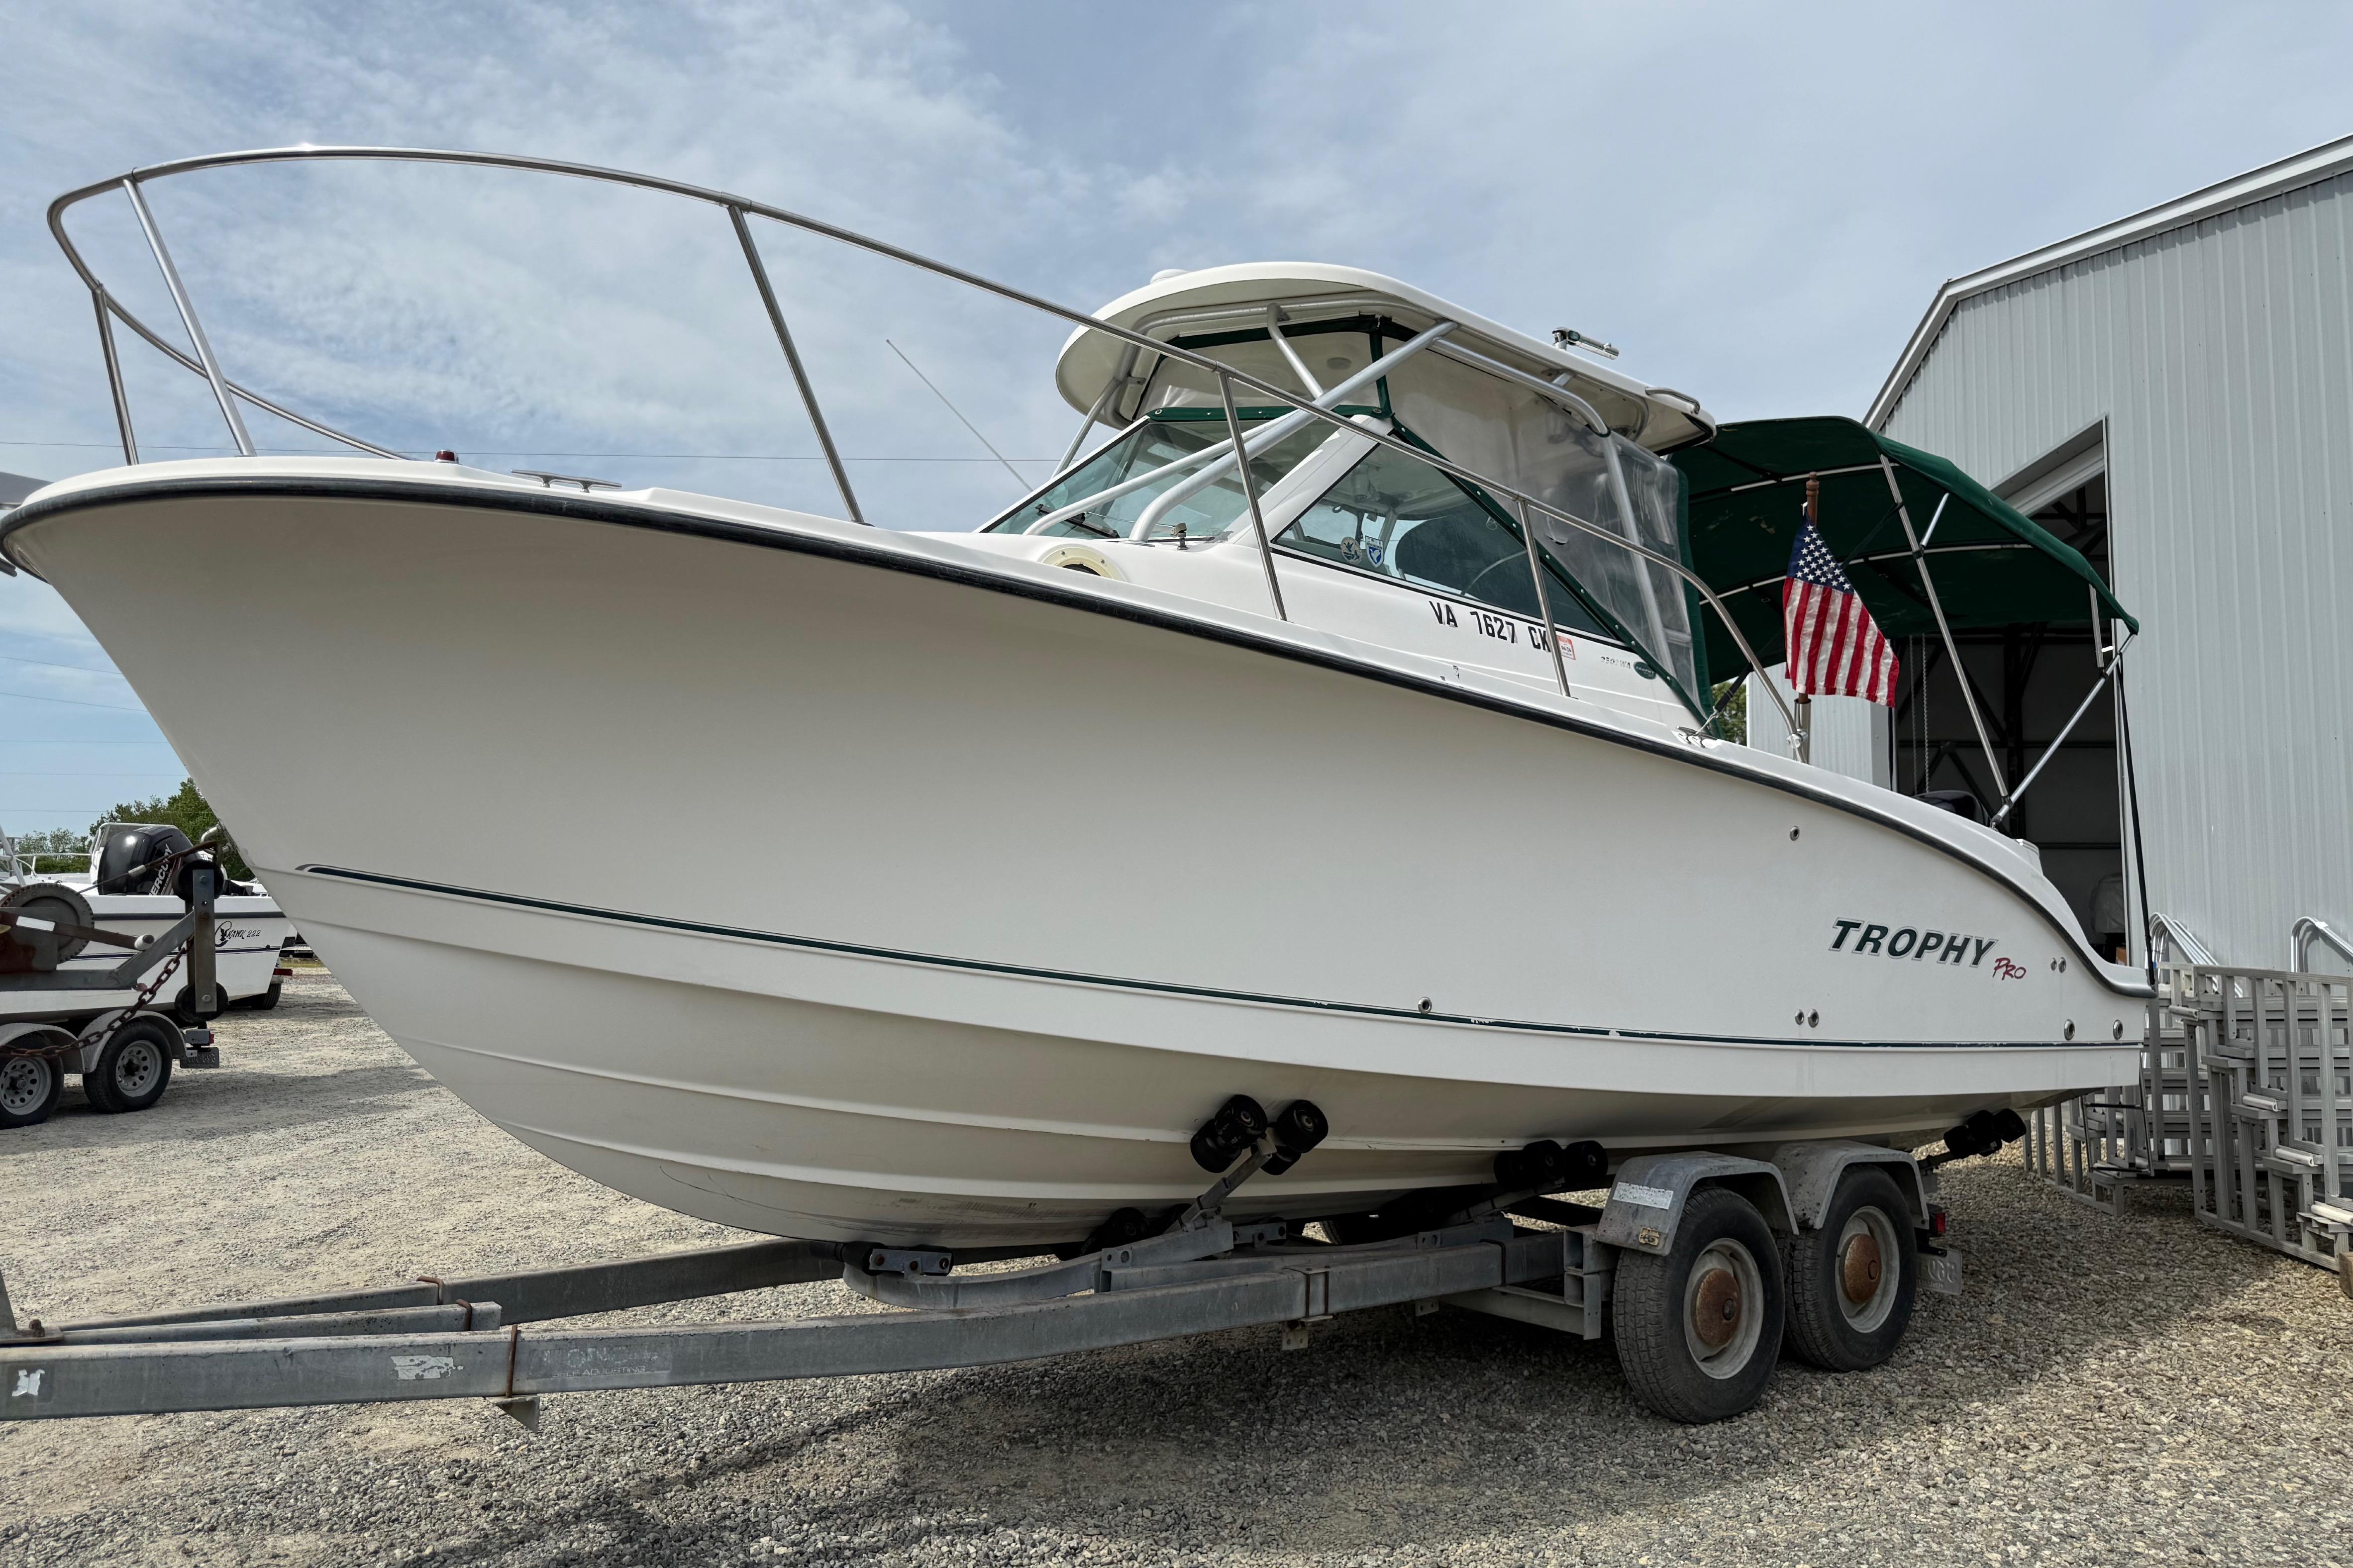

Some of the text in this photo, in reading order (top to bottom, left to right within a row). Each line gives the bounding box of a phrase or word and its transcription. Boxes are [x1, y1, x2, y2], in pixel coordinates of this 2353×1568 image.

[1429, 601, 1551, 653] VA 7627 CK
[1829, 917, 1998, 968] TROPHY
